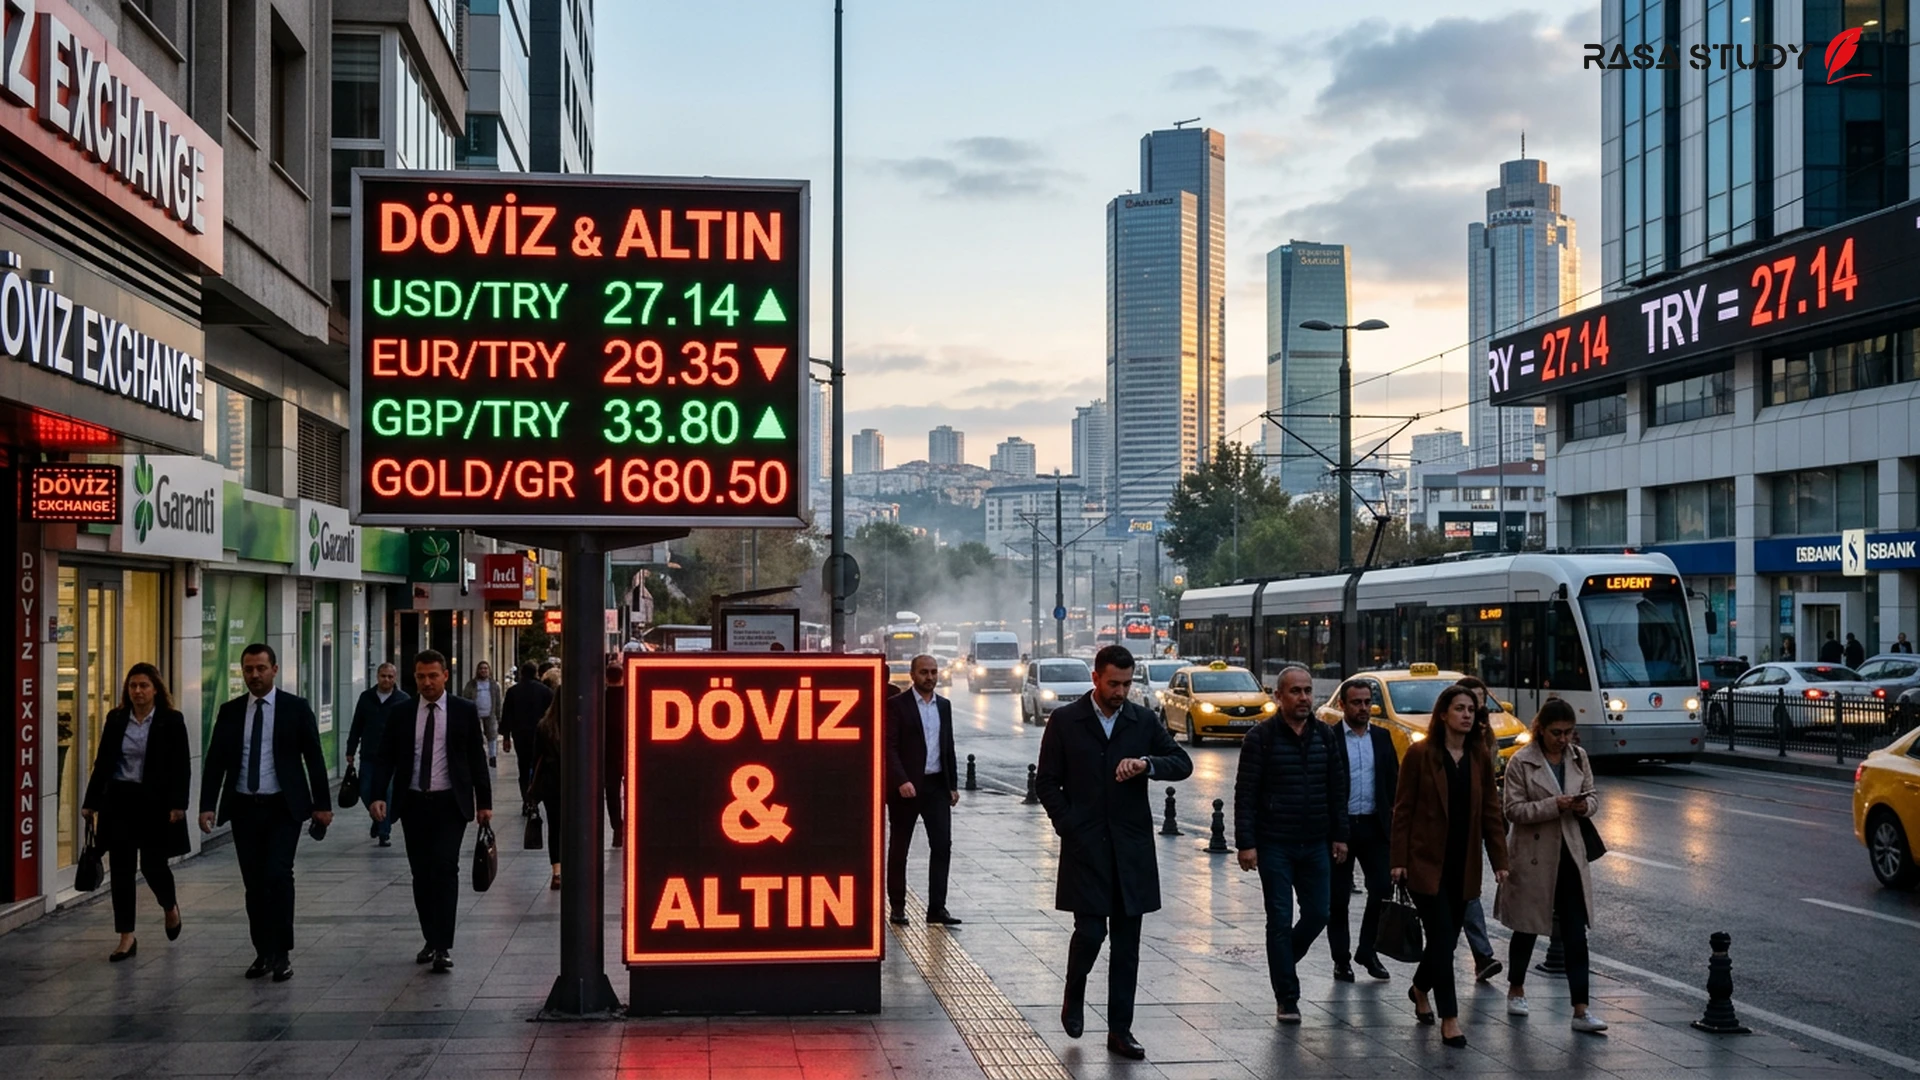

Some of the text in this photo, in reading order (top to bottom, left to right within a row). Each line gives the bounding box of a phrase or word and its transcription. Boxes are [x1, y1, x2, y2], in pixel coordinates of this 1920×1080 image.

[48, 12, 205, 235] EXCHANGE
[380, 192, 781, 261] DÖVİZ & ALTIN
[372, 278, 740, 326] USD/TRY 27.14
[1541, 315, 1610, 382] 27.14
[1641, 283, 1708, 354] TRY
[1717, 288, 1740, 322] =
[1750, 237, 1859, 327] 27.14
[82, 305, 203, 422] EXCHANGE
[372, 338, 740, 386] EUR/TRY 29.35
[371, 398, 740, 444] GBP/TRY 33.80
[38, 473, 110, 496] DÖVİZ
[38, 499, 111, 512] EXCHANGE
[156, 474, 215, 535] Garanti
[371, 458, 788, 504] GOLD/GR 1680.50
[1866, 541, 1917, 560] ISBANK
[1606, 576, 1653, 590] LEVENT
[20, 552, 34, 859] DÖVİZ EXCHANGE
[651, 676, 861, 741] DÖVİZ
[720, 763, 793, 844] &
[650, 875, 855, 930] ALTIN
